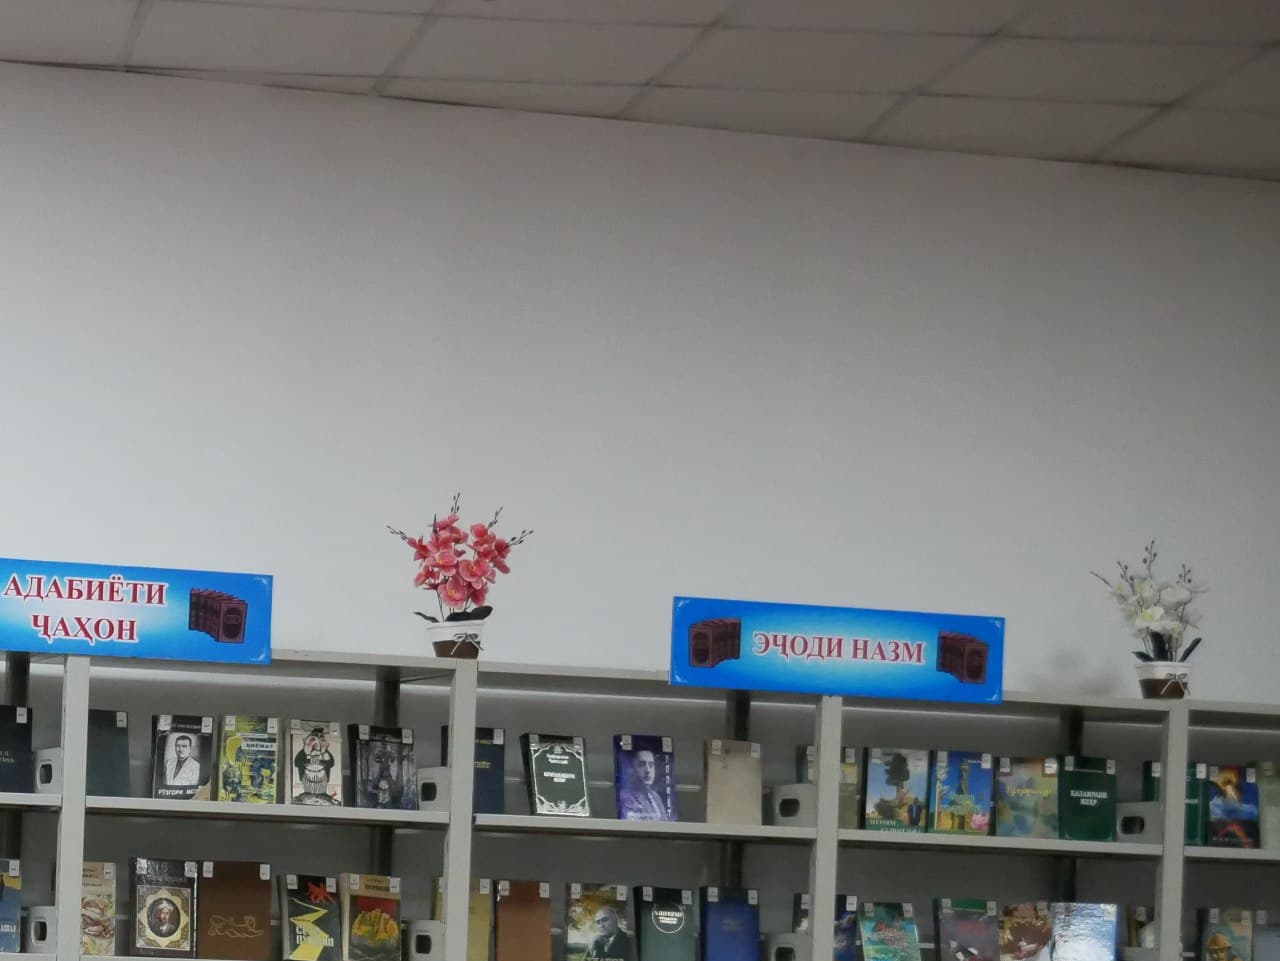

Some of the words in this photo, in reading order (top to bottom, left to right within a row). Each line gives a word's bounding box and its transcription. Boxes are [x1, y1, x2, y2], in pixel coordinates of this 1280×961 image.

[3, 574, 167, 605] АДАБИЁТИ
[31, 614, 137, 643] ҶАҲОН
[753, 632, 844, 661] ЭҶОДИ
[852, 638, 925, 664] НАЗМ
